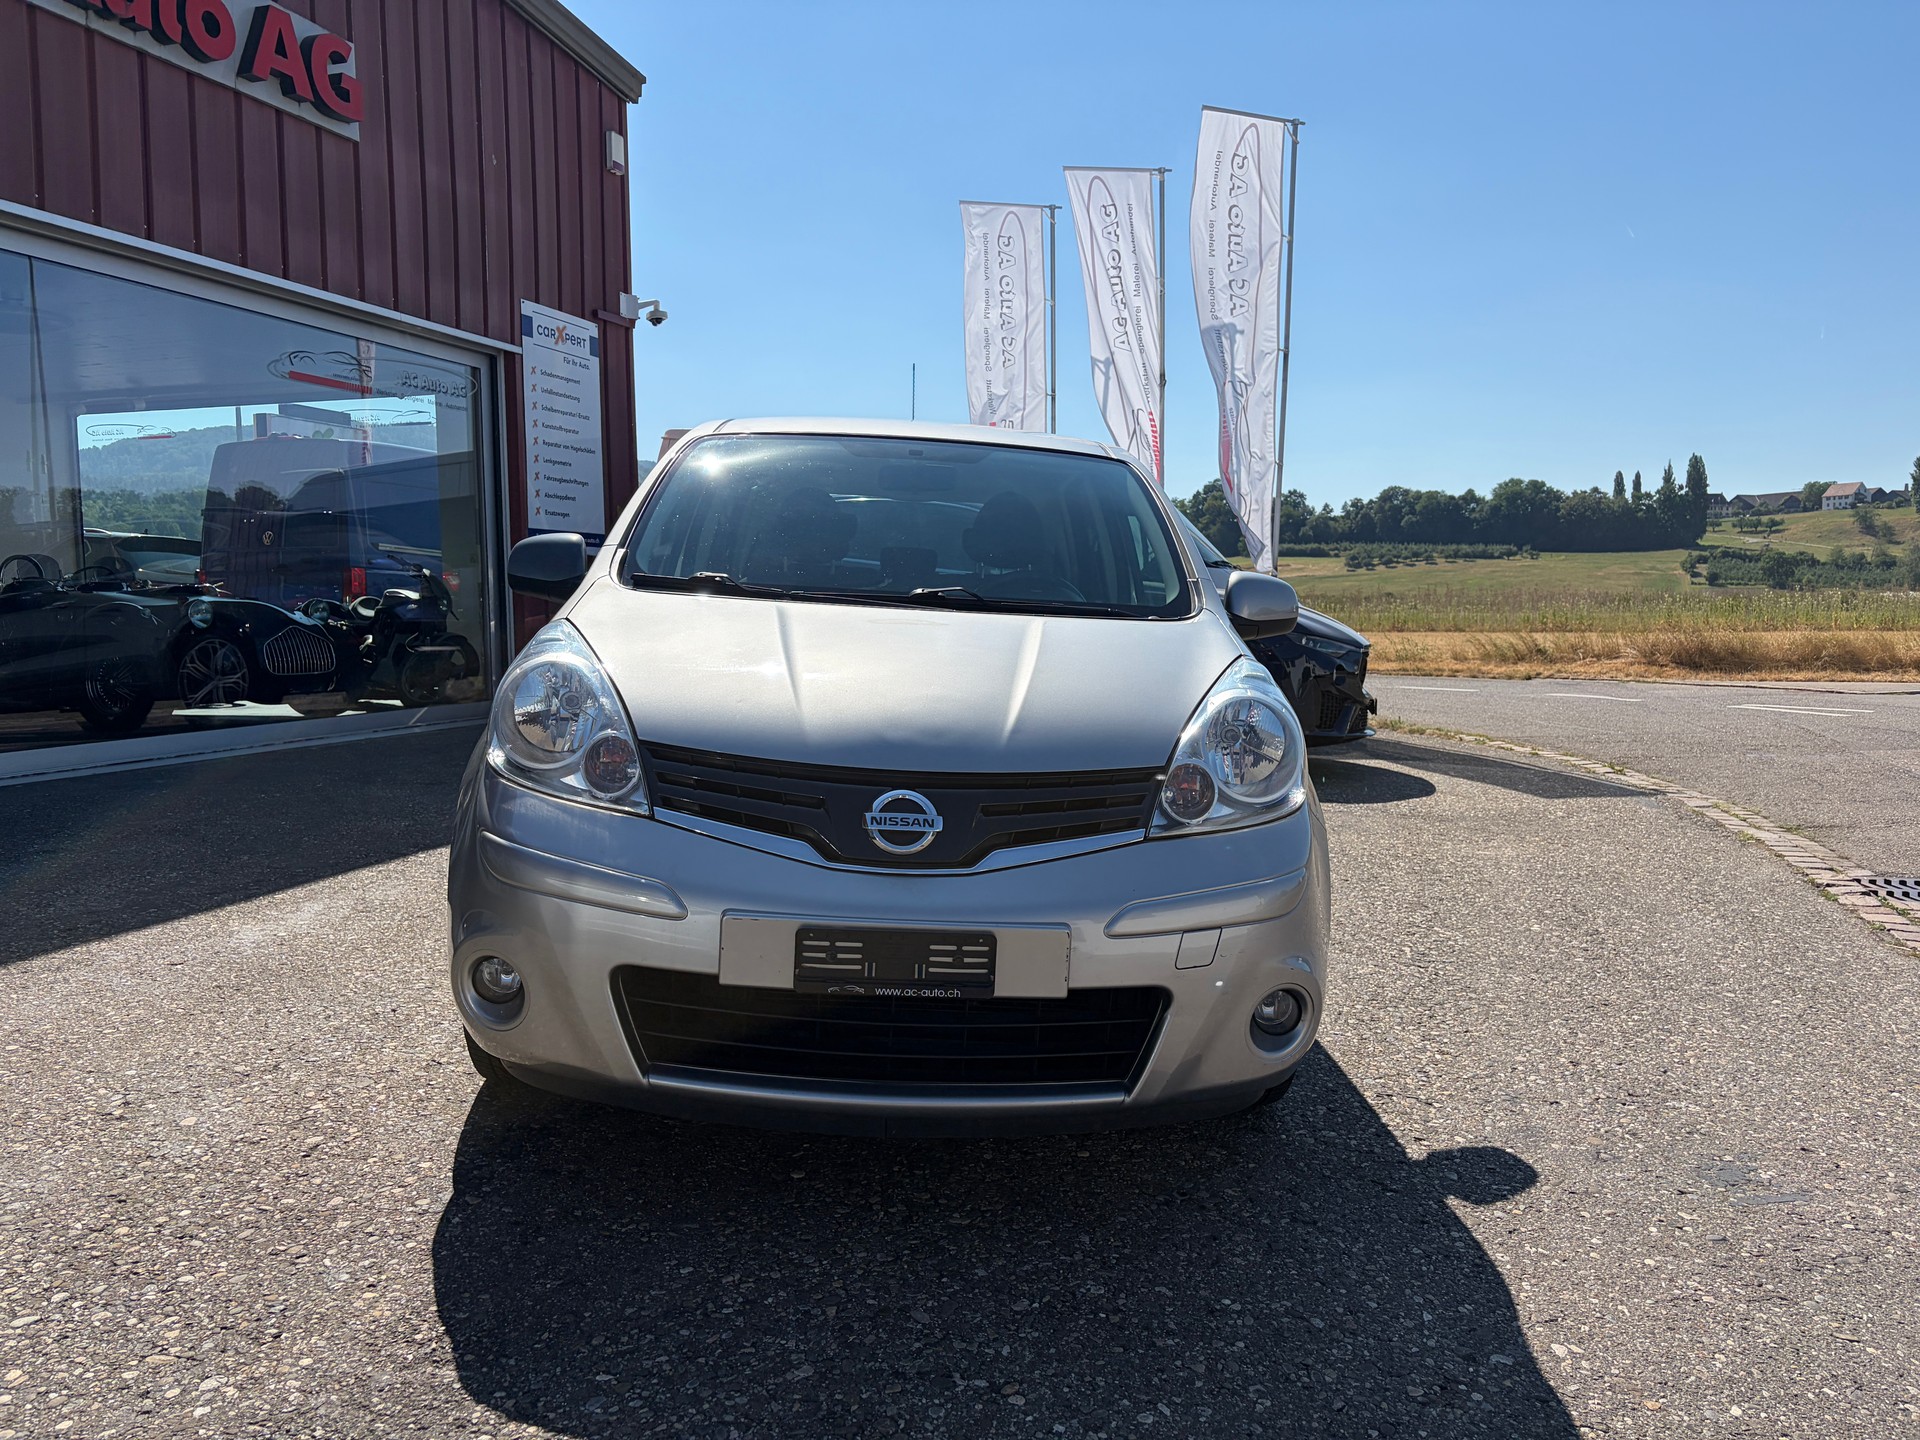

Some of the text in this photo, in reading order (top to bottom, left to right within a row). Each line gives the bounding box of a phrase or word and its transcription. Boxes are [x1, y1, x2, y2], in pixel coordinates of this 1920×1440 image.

[240, 5, 365, 122] AG
[1099, 203, 1120, 244] AG
[1127, 203, 1137, 256] Autohandel
[1131, 262, 1142, 298] Malerei
[563, 356, 572, 365] Für
[421, 374, 449, 394] Auto
[869, 815, 935, 829] NISSAN
[874, 987, 962, 999] www.ac-auto.ch
